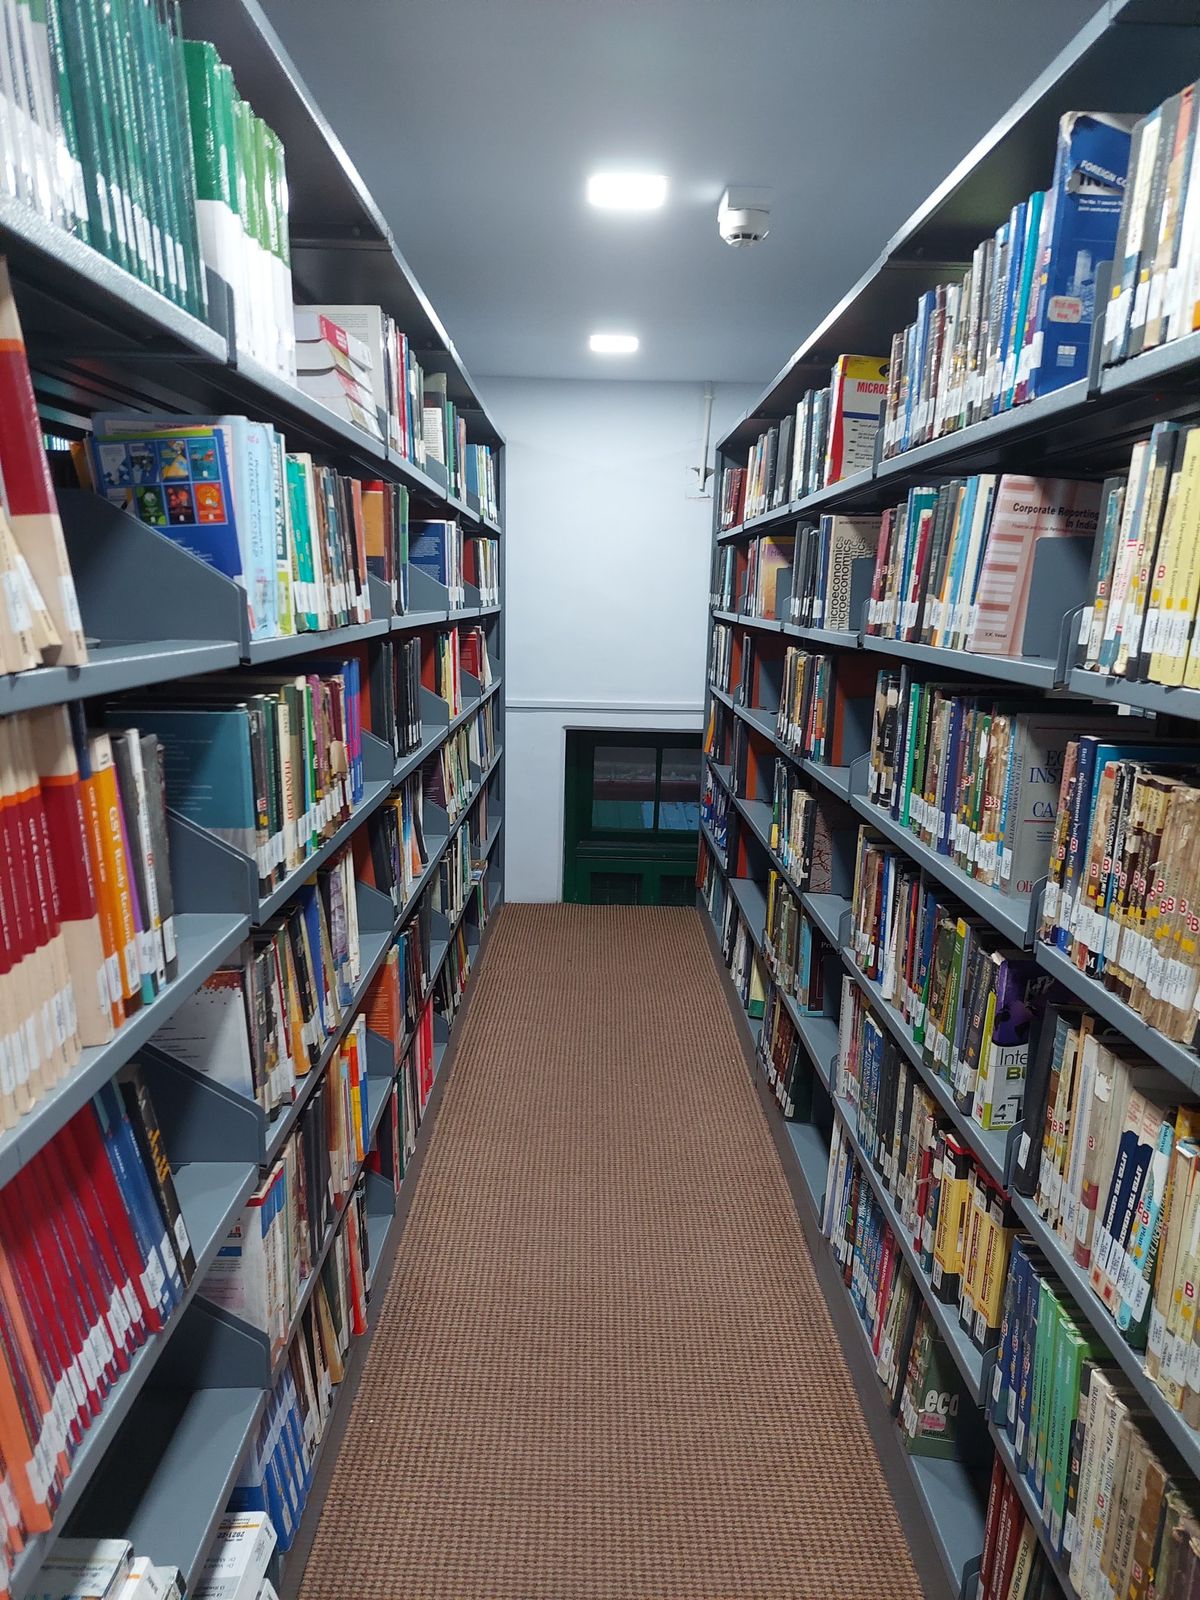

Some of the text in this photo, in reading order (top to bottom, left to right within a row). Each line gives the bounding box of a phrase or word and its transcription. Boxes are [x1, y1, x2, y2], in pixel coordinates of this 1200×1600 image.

[1081, 160, 1117, 182] FOREIGN
[1012, 502, 1100, 520] Corporate Reporting
[1076, 518, 1098, 529] India
[830, 536, 843, 628] microeconomics
[838, 538, 851, 630] microeconomics
[1080, 747, 1088, 764] Bell
[1072, 772, 1086, 822] Development
[92, 810, 98, 819] &
[108, 806, 122, 842] GST
[93, 820, 103, 862] Customs
[114, 848, 126, 888] Ready
[1000, 1051, 1028, 1066] Inte
[1116, 1151, 1128, 1178] AFTER
[1113, 1178, 1122, 1194] THE
[1131, 1165, 1143, 1192] AFTER
[1127, 1192, 1136, 1209] THE
[1089, 1386, 1099, 1423] DASGUPTA
[1010, 1541, 1030, 1600] DEVELOPMENT
